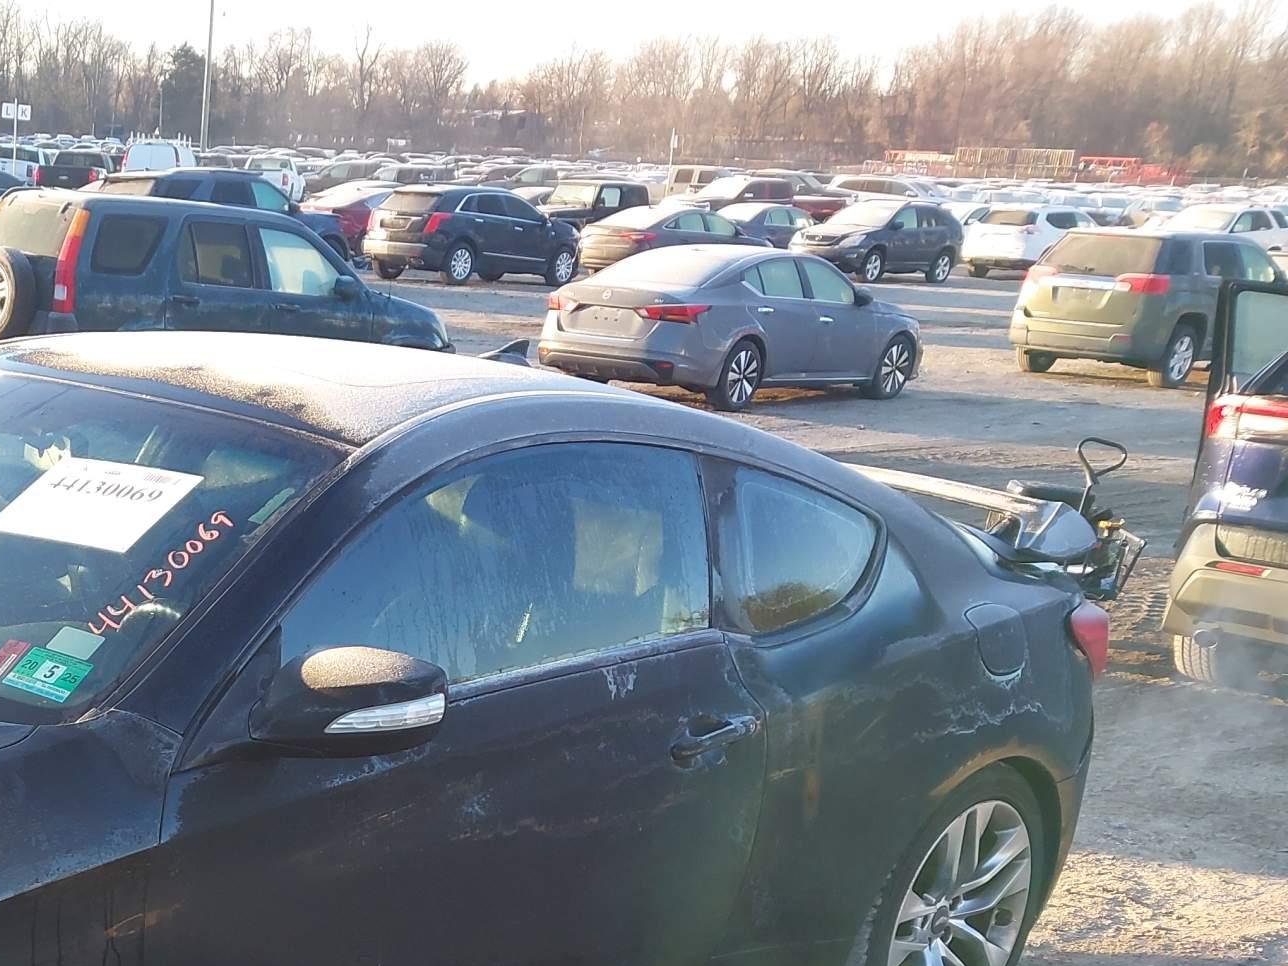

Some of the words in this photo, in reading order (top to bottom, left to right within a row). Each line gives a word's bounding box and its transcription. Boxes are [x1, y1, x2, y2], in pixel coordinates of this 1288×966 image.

[5, 105, 11, 116] L
[21, 106, 28, 118] K
[49, 477, 164, 501] 44130069
[88, 511, 233, 634] 44130069
[21, 659, 39, 671] 20
[43, 665, 60, 679] 5
[60, 672, 81, 684] 25
